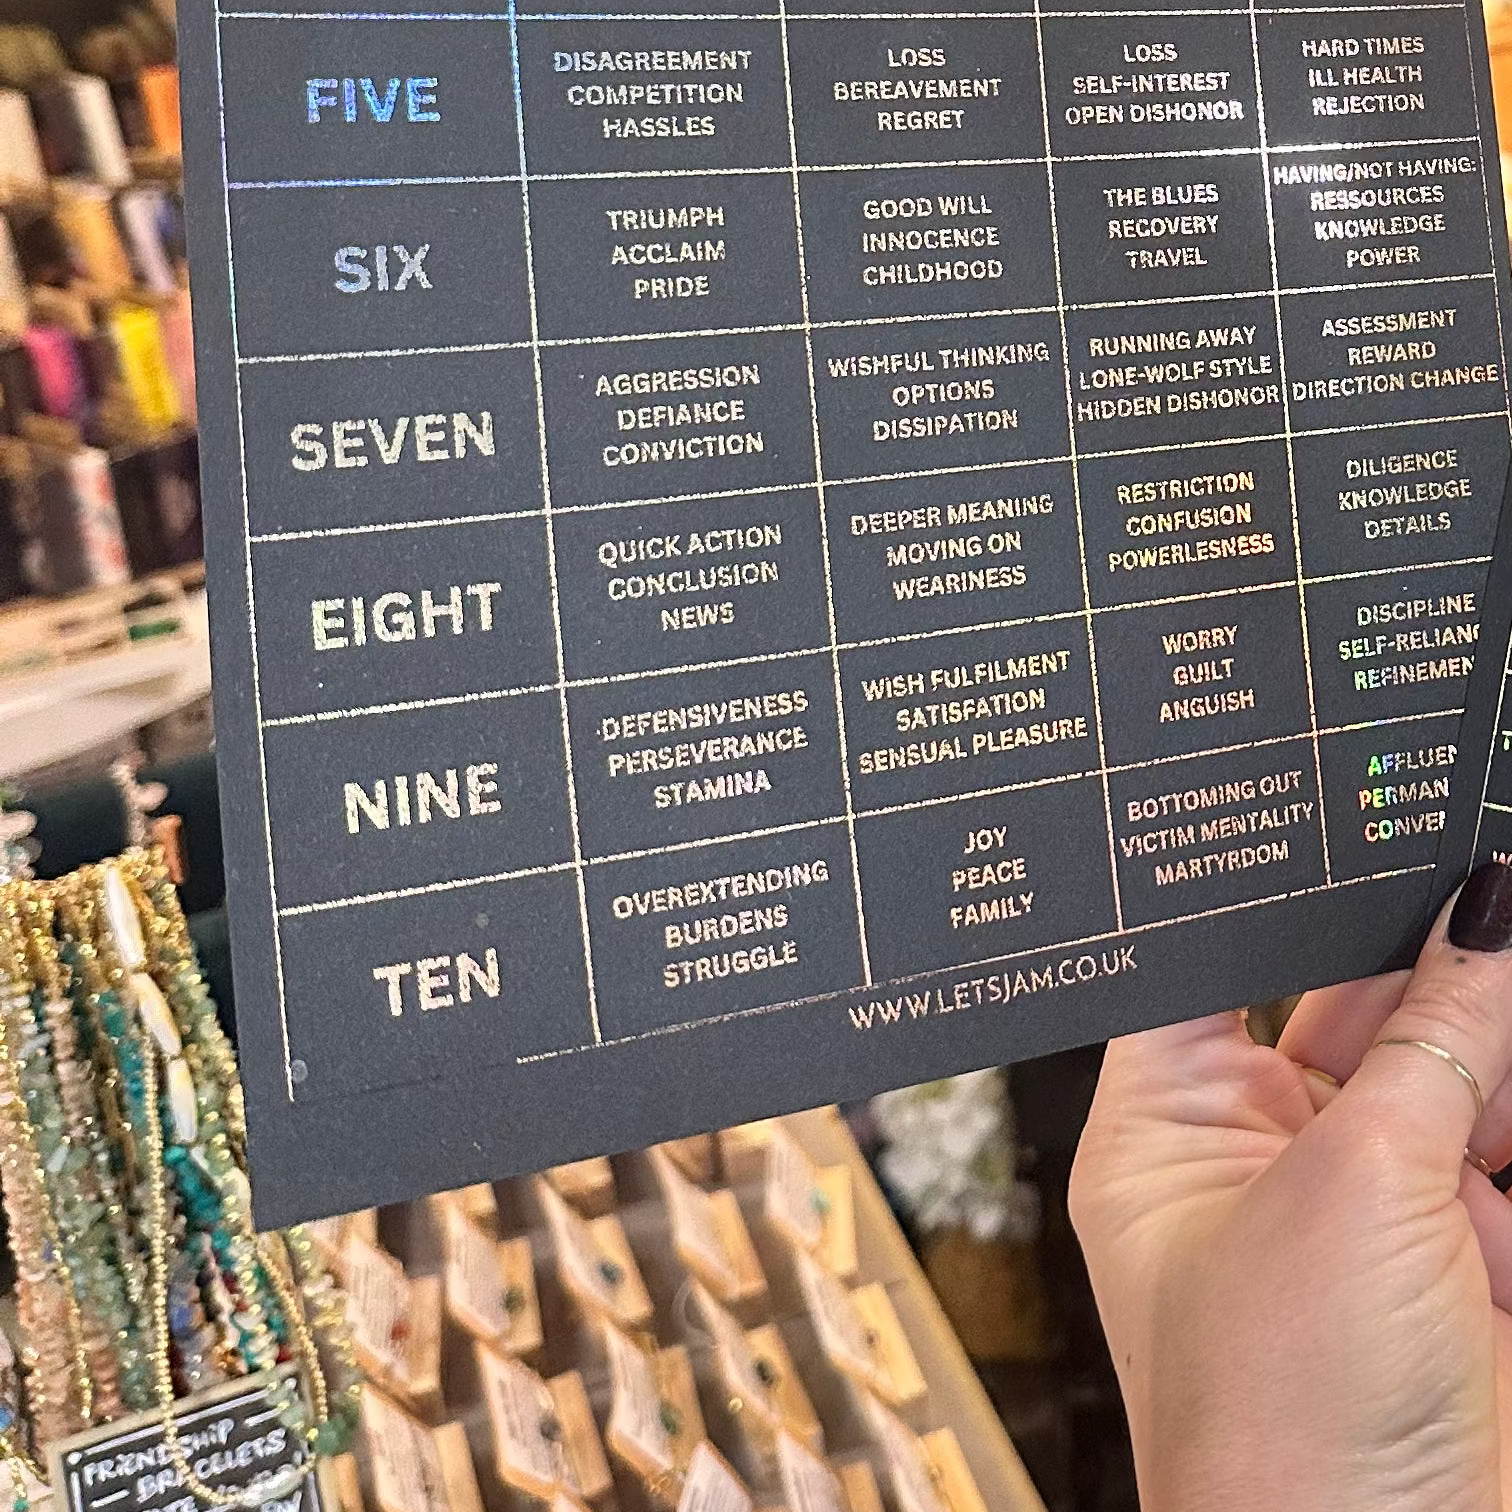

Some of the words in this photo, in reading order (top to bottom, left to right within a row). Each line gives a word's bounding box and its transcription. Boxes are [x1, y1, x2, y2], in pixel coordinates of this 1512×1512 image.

[554, 50, 751, 71] DISAGREEMENT
[1123, 43, 1177, 62] LOSS
[305, 77, 440, 122] FIVE
[1312, 93, 1424, 115] REJECTION
[877, 109, 964, 130] REGRET
[605, 206, 723, 230] TRIUMPH
[1108, 214, 1217, 238] RECOVERY
[1314, 214, 1445, 241] KNOWLEDGE
[334, 244, 432, 293] SIX
[863, 259, 1002, 284] CHILDHOOD
[1322, 309, 1456, 336] ASSESSMENT
[1090, 331, 1190, 356] RUNNING
[1195, 326, 1256, 348] AWAY
[892, 379, 994, 406] OPTIONS
[290, 411, 494, 471] SEVEN
[603, 432, 763, 465] CONVICTION
[1338, 478, 1471, 510] KNOWLEDGE
[1126, 502, 1251, 535] CONFUSION
[892, 564, 1025, 599] WEARINESS
[310, 582, 501, 650] EIGHT
[661, 602, 734, 630] NEWS
[1162, 625, 1236, 654] WORRY
[896, 688, 1044, 731] SATISFATION
[344, 763, 500, 833] NINE
[653, 769, 770, 808] STAMINA
[964, 826, 1006, 853] JOY
[1155, 839, 1288, 885] MARTYRDOM
[612, 860, 828, 918] OVEREXTENDING
[373, 948, 499, 1016] TEN
[848, 945, 1137, 1029] WWW.LETSJAM.CO.UK
